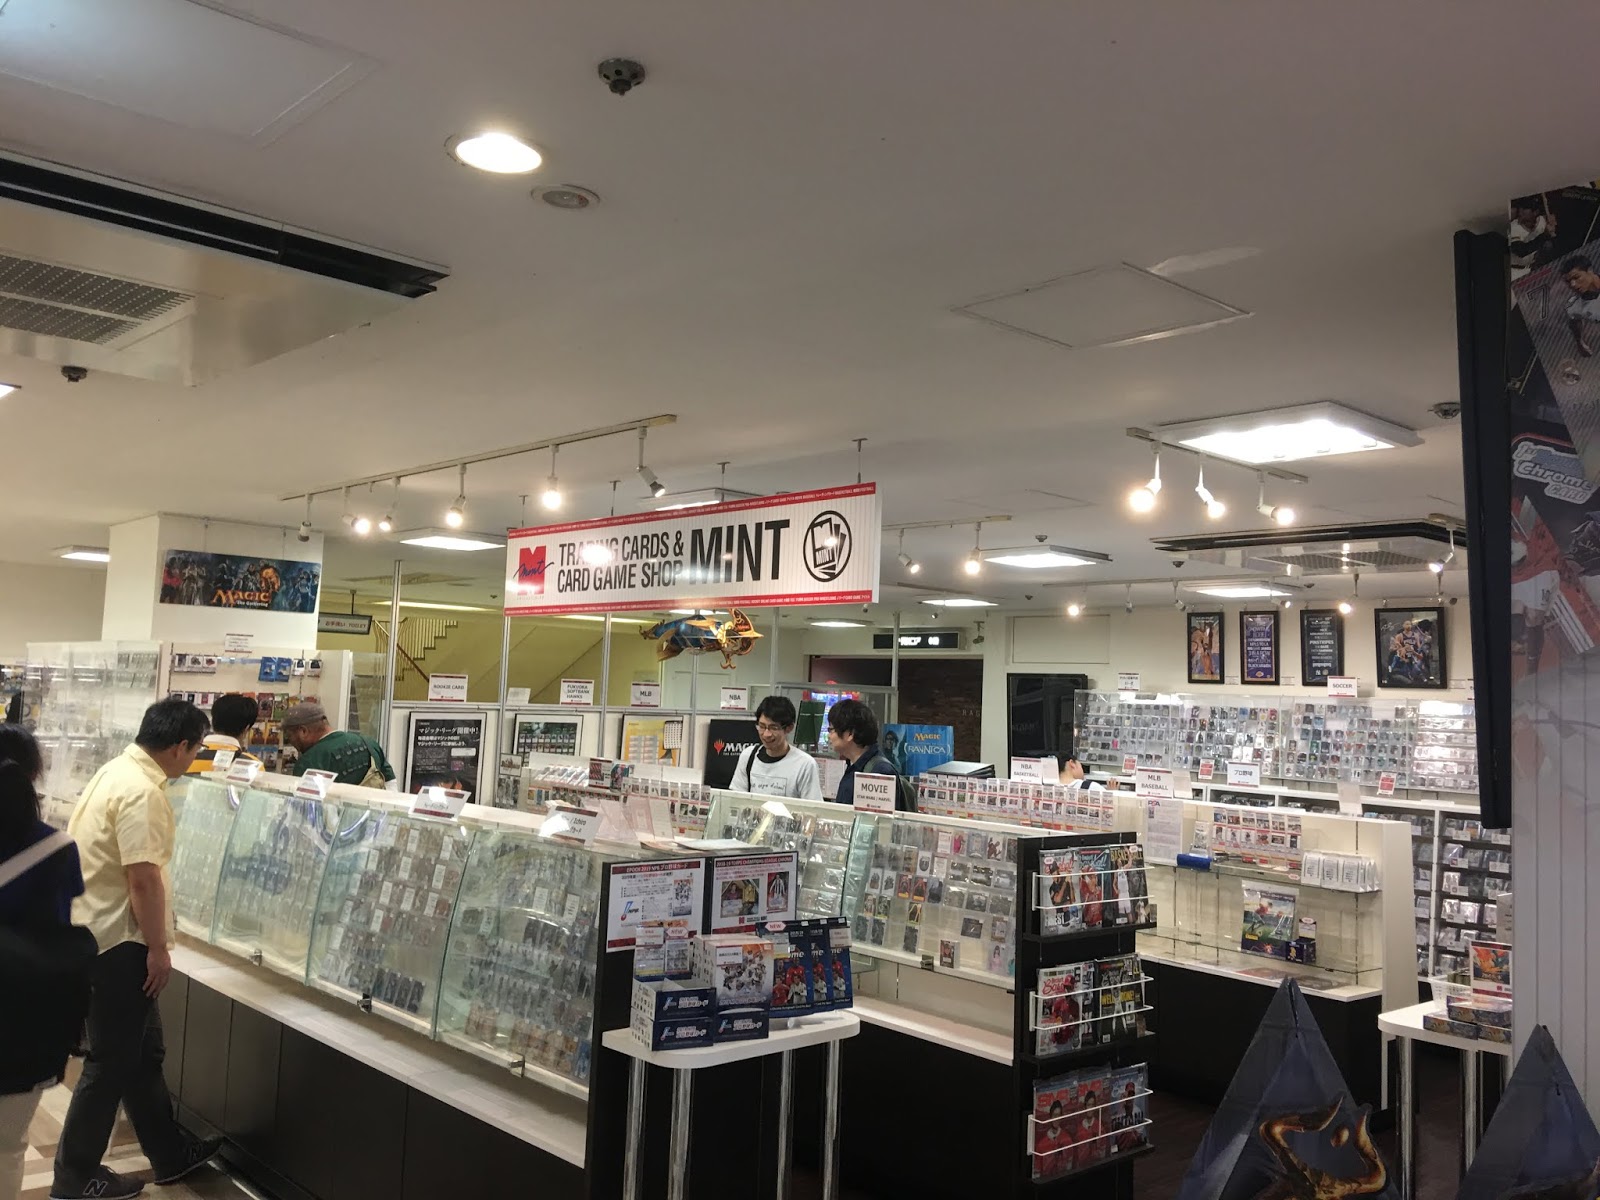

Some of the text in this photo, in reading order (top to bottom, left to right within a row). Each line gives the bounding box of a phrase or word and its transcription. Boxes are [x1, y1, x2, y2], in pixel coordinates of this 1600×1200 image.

[1517, 460, 1593, 491] Chrome
[1549, 484, 1587, 501] CARD
[622, 532, 669, 561] CARDS
[673, 530, 684, 557] &
[688, 518, 790, 585] MINT
[557, 560, 684, 593] CARD GAME SHOP
[861, 782, 888, 794] MOVIE
[1140, 782, 1169, 791] BASEBALL
[1147, 774, 1162, 782] MLB
